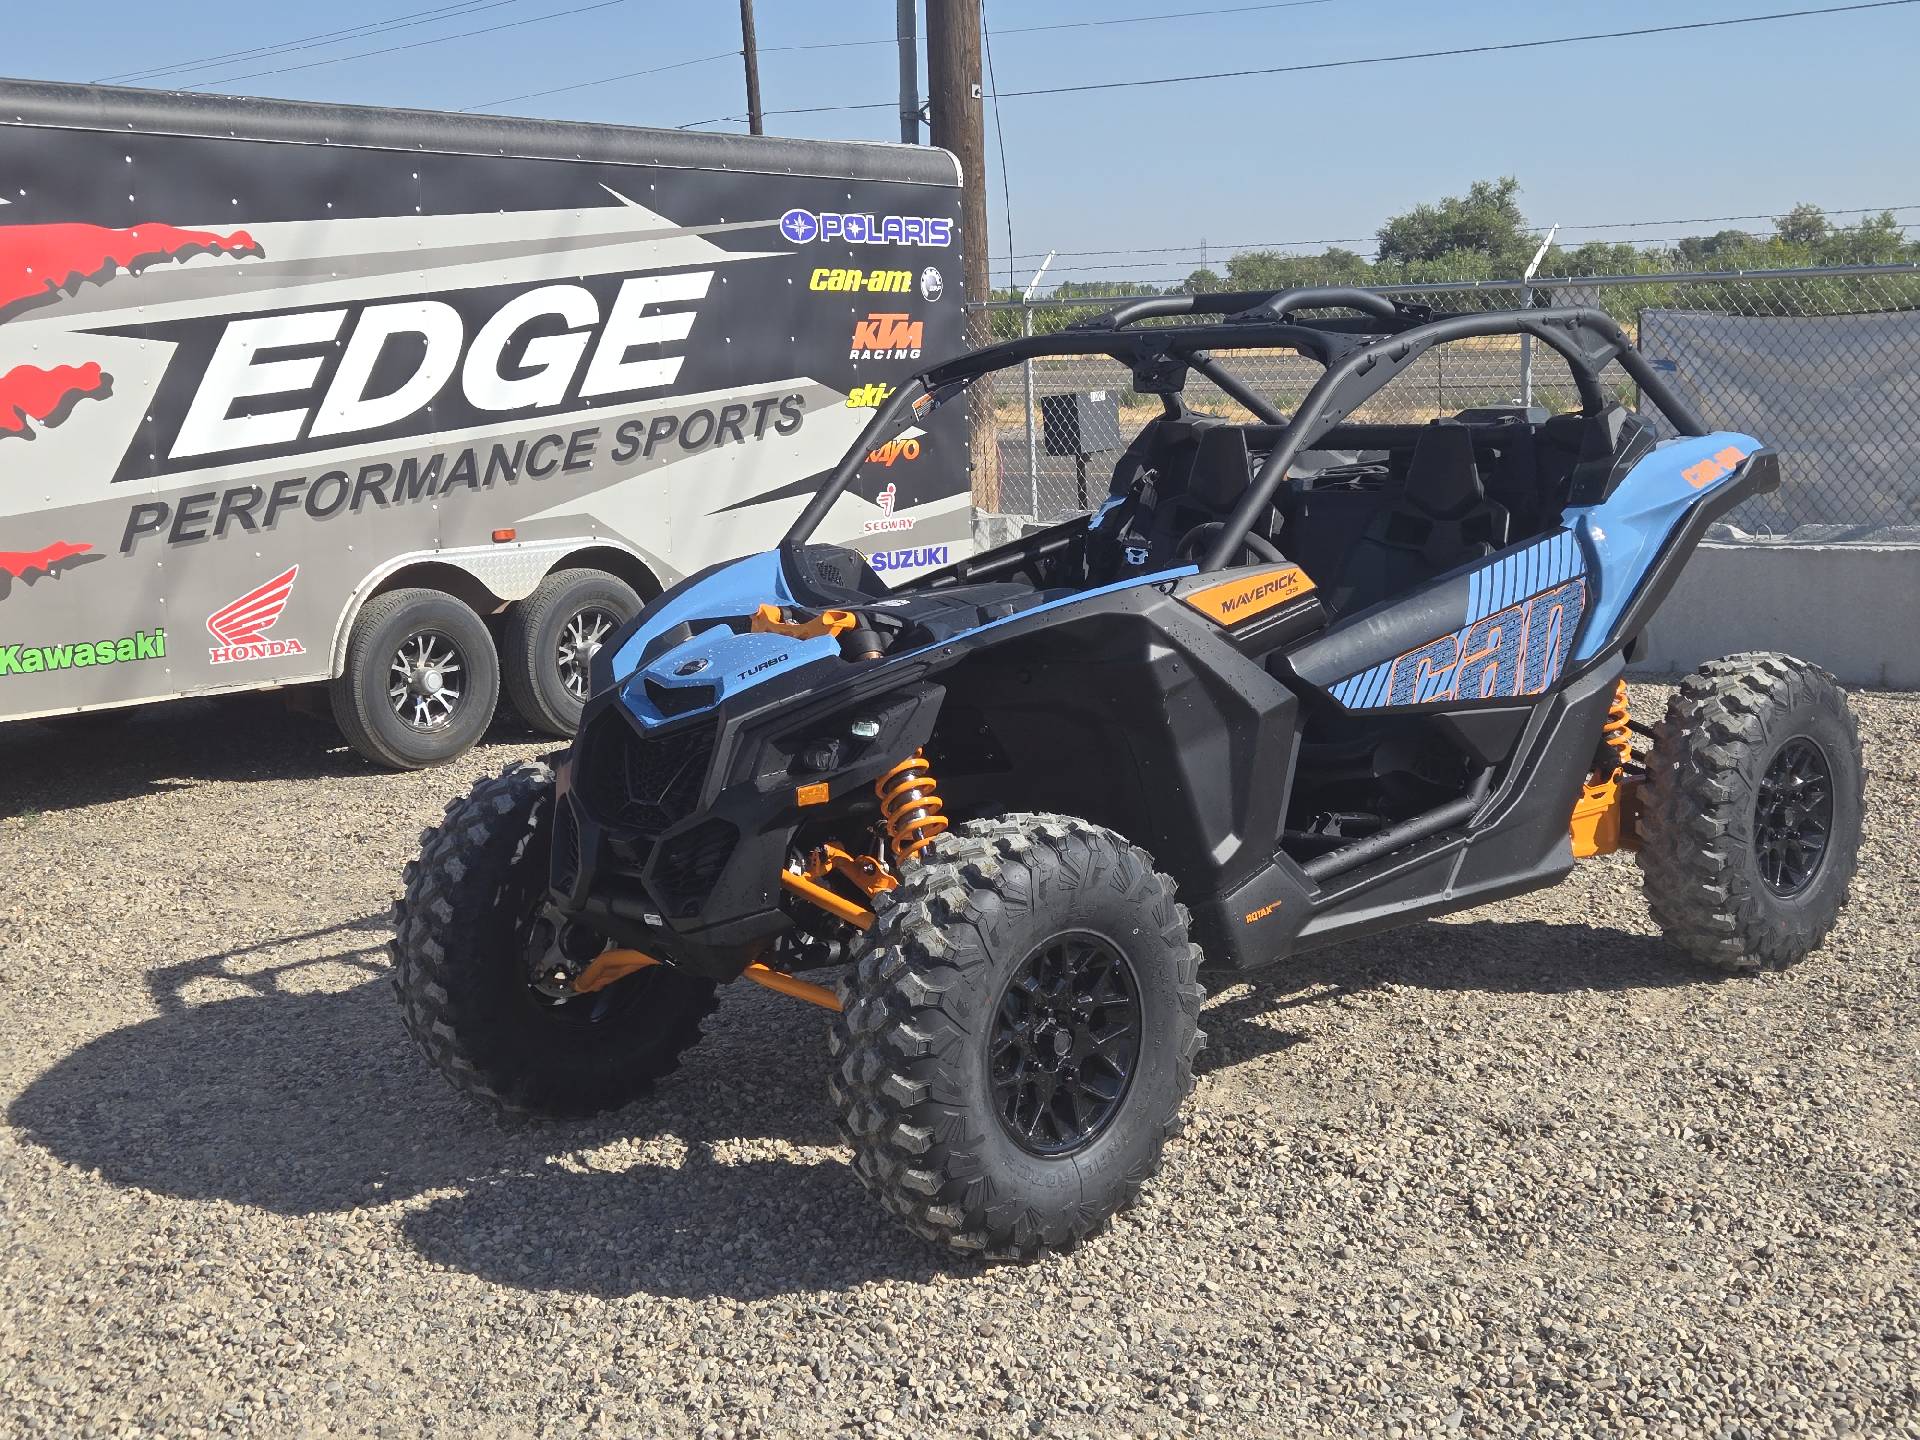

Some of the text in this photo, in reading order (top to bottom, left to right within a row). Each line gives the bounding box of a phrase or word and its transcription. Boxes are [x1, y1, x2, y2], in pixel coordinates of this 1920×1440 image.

[819, 212, 953, 247] POLARIS
[809, 268, 913, 293] can-am
[851, 313, 924, 350] KTM
[168, 271, 715, 460] EDGE
[849, 350, 921, 360] RACING
[845, 382, 897, 408] ski-
[119, 393, 805, 555] PERFORMANCE SPORTS
[864, 518, 914, 533] SEGWAY
[871, 546, 948, 572] SUZUKI
[1220, 571, 1299, 614] MAVERICK
[0, 627, 166, 677] Kawasaki
[209, 638, 306, 664] HONDA
[737, 653, 789, 681] TURBO
